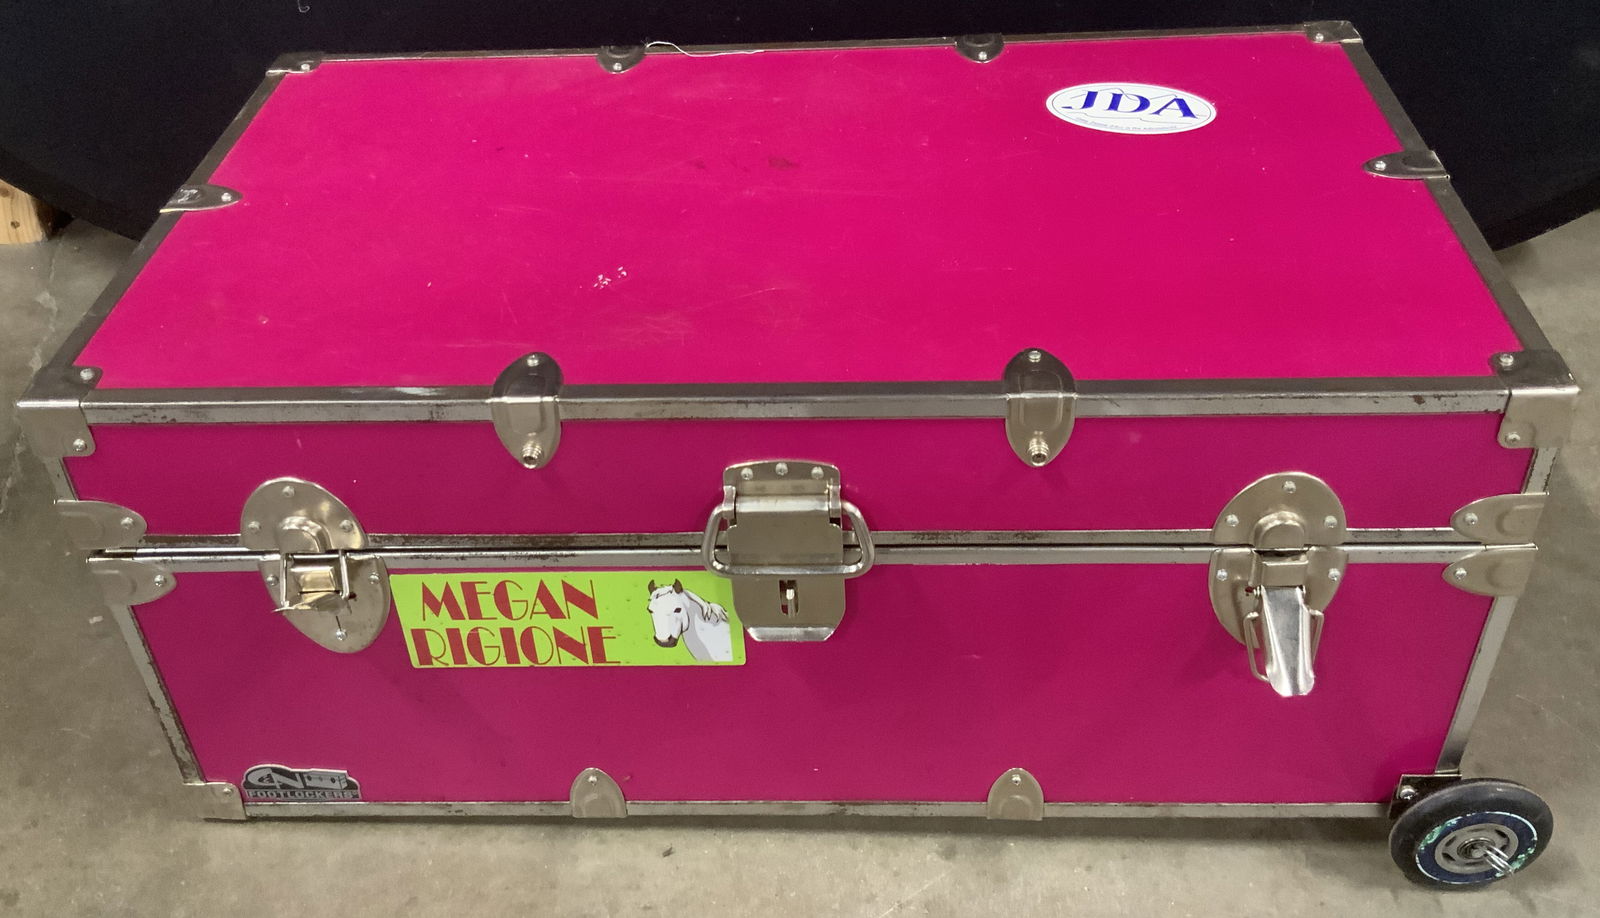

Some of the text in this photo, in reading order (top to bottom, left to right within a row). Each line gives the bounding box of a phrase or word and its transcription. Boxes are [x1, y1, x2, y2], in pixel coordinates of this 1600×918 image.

[1061, 90, 1198, 119] JDA
[421, 579, 599, 621] MEGAN
[410, 626, 621, 666] RIGIONE
[248, 789, 354, 799] FOOTLOCKERS
